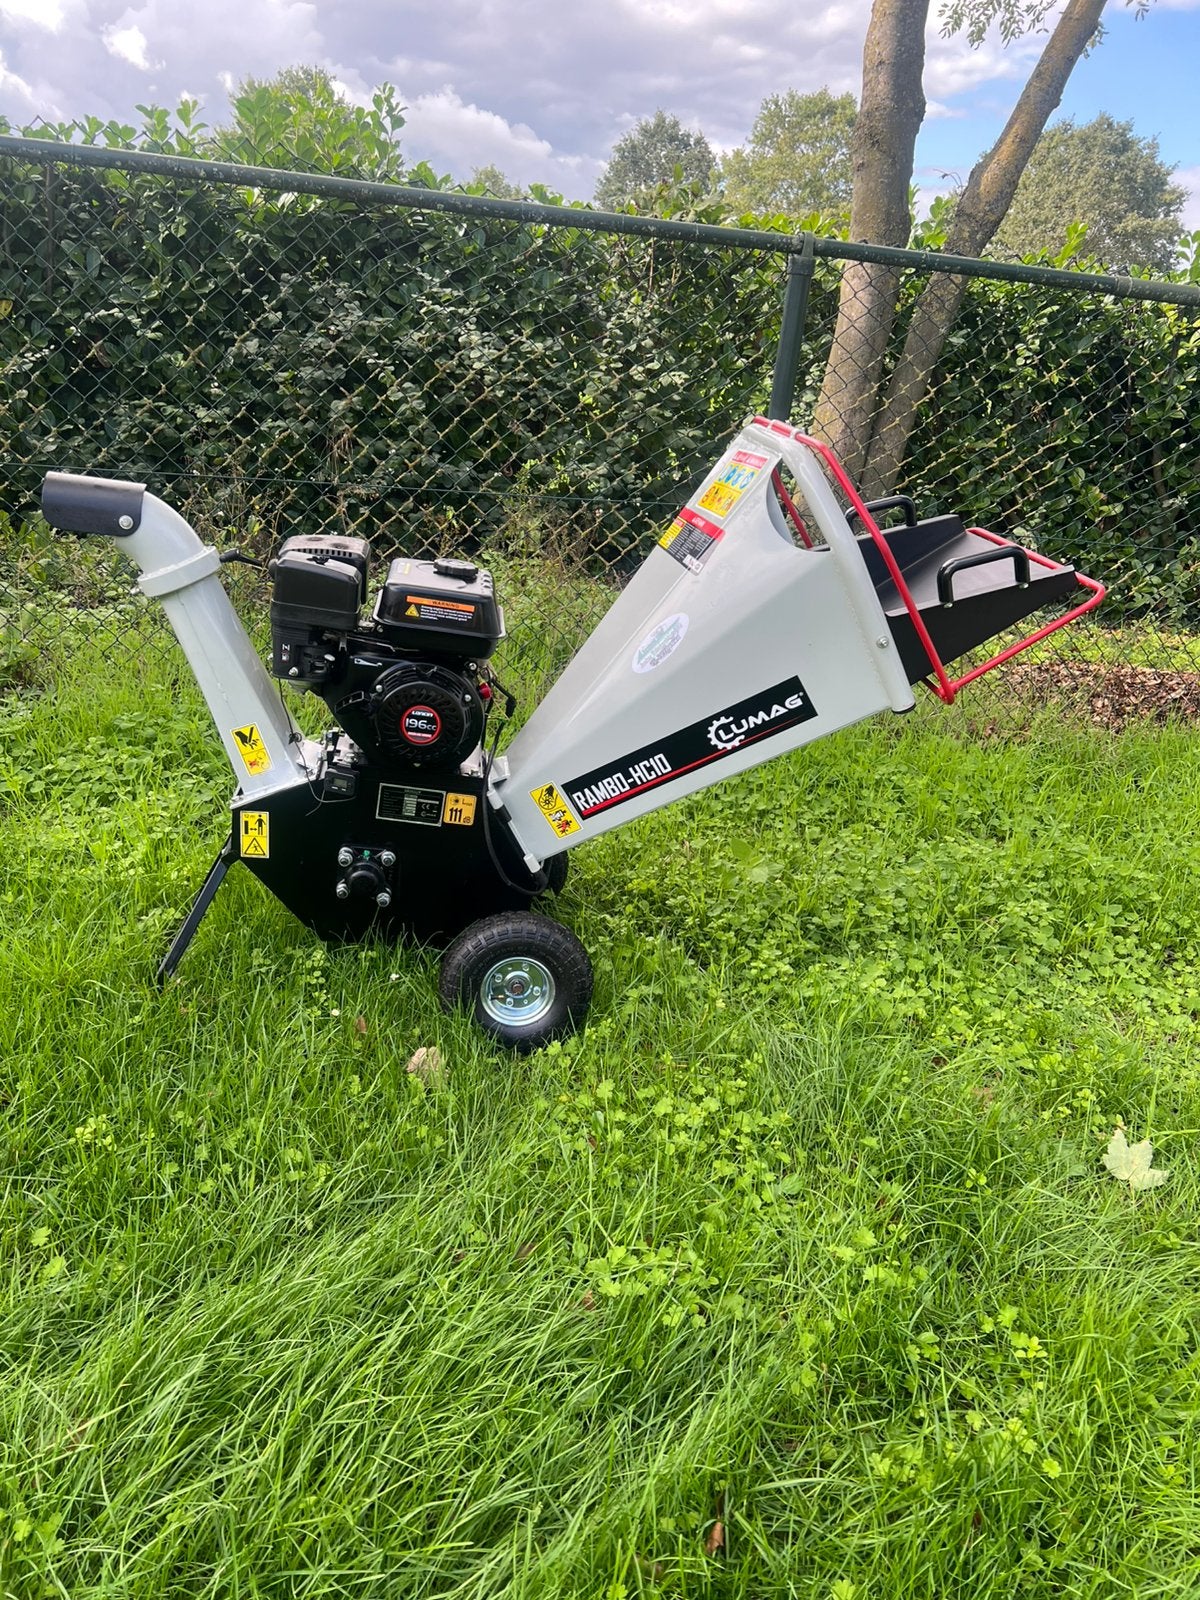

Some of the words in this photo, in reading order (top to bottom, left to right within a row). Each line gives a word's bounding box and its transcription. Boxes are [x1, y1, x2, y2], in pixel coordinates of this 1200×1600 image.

[405, 717, 437, 731] 196cc
[572, 753, 673, 812] RAMBO-HC10
[448, 806, 463, 823] 111
